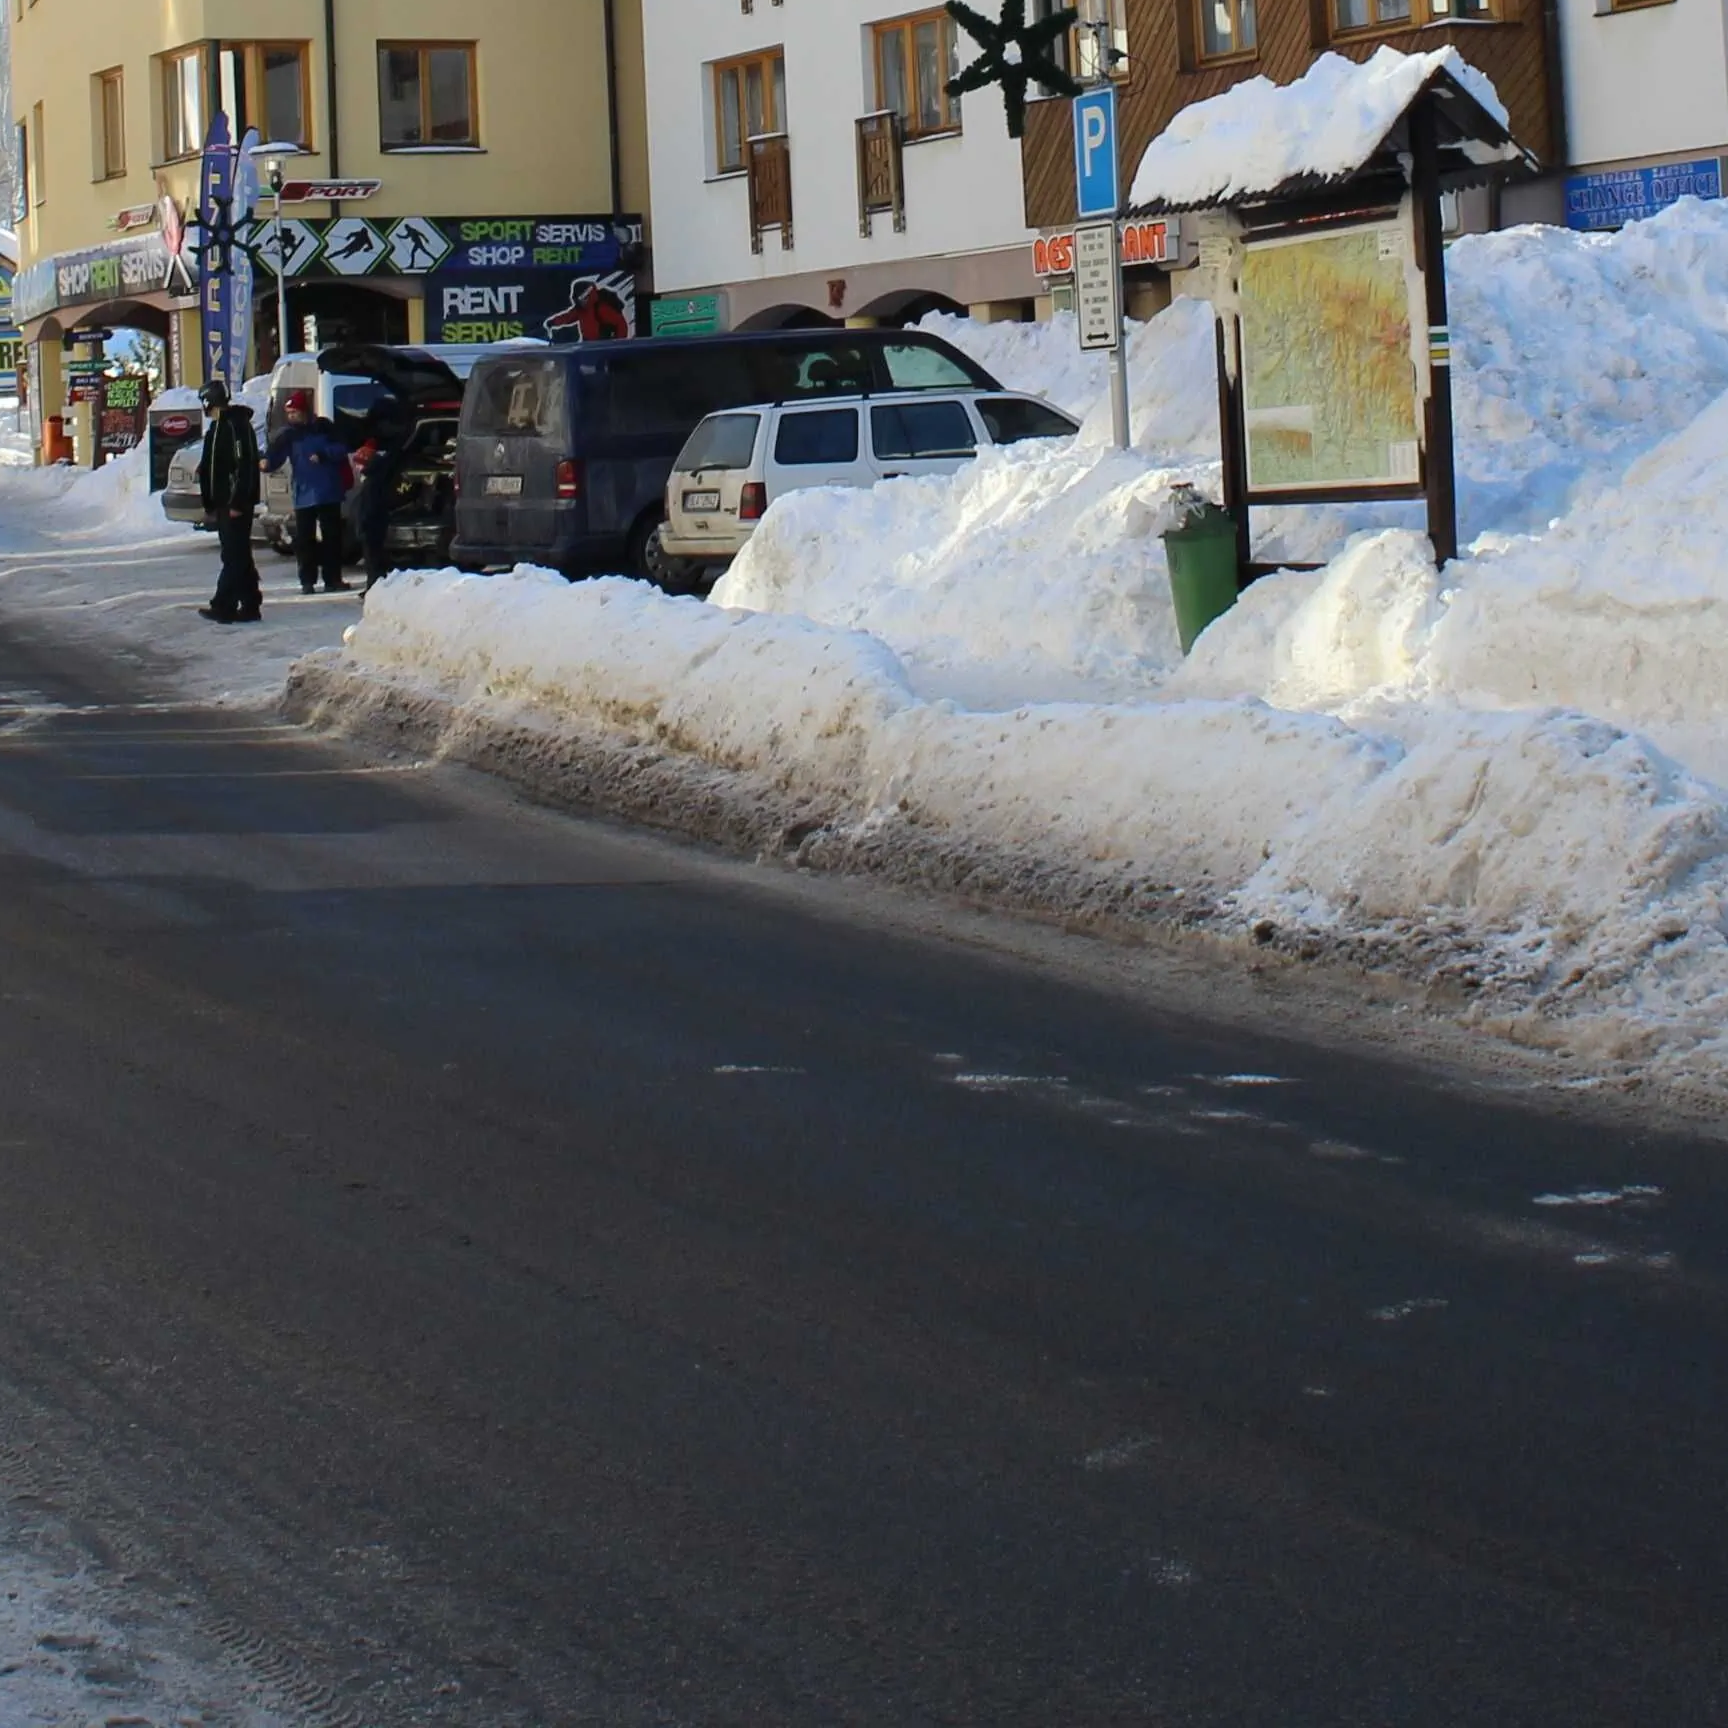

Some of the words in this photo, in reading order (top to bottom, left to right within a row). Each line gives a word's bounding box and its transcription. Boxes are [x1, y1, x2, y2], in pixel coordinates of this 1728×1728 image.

[1081, 105, 1107, 177] P
[1568, 181, 1646, 213] CHANGE
[1651, 172, 1719, 201] OFFICE
[460, 220, 535, 242] SPORT
[535, 223, 605, 244] SERVIS
[58, 263, 89, 297] SHOP
[89, 255, 121, 290] RENT
[122, 247, 165, 285] SERVIS
[468, 246, 525, 266] SHOP
[533, 247, 583, 265] RENT
[442, 284, 525, 320] RENT
[441, 321, 525, 343] SERVIS
